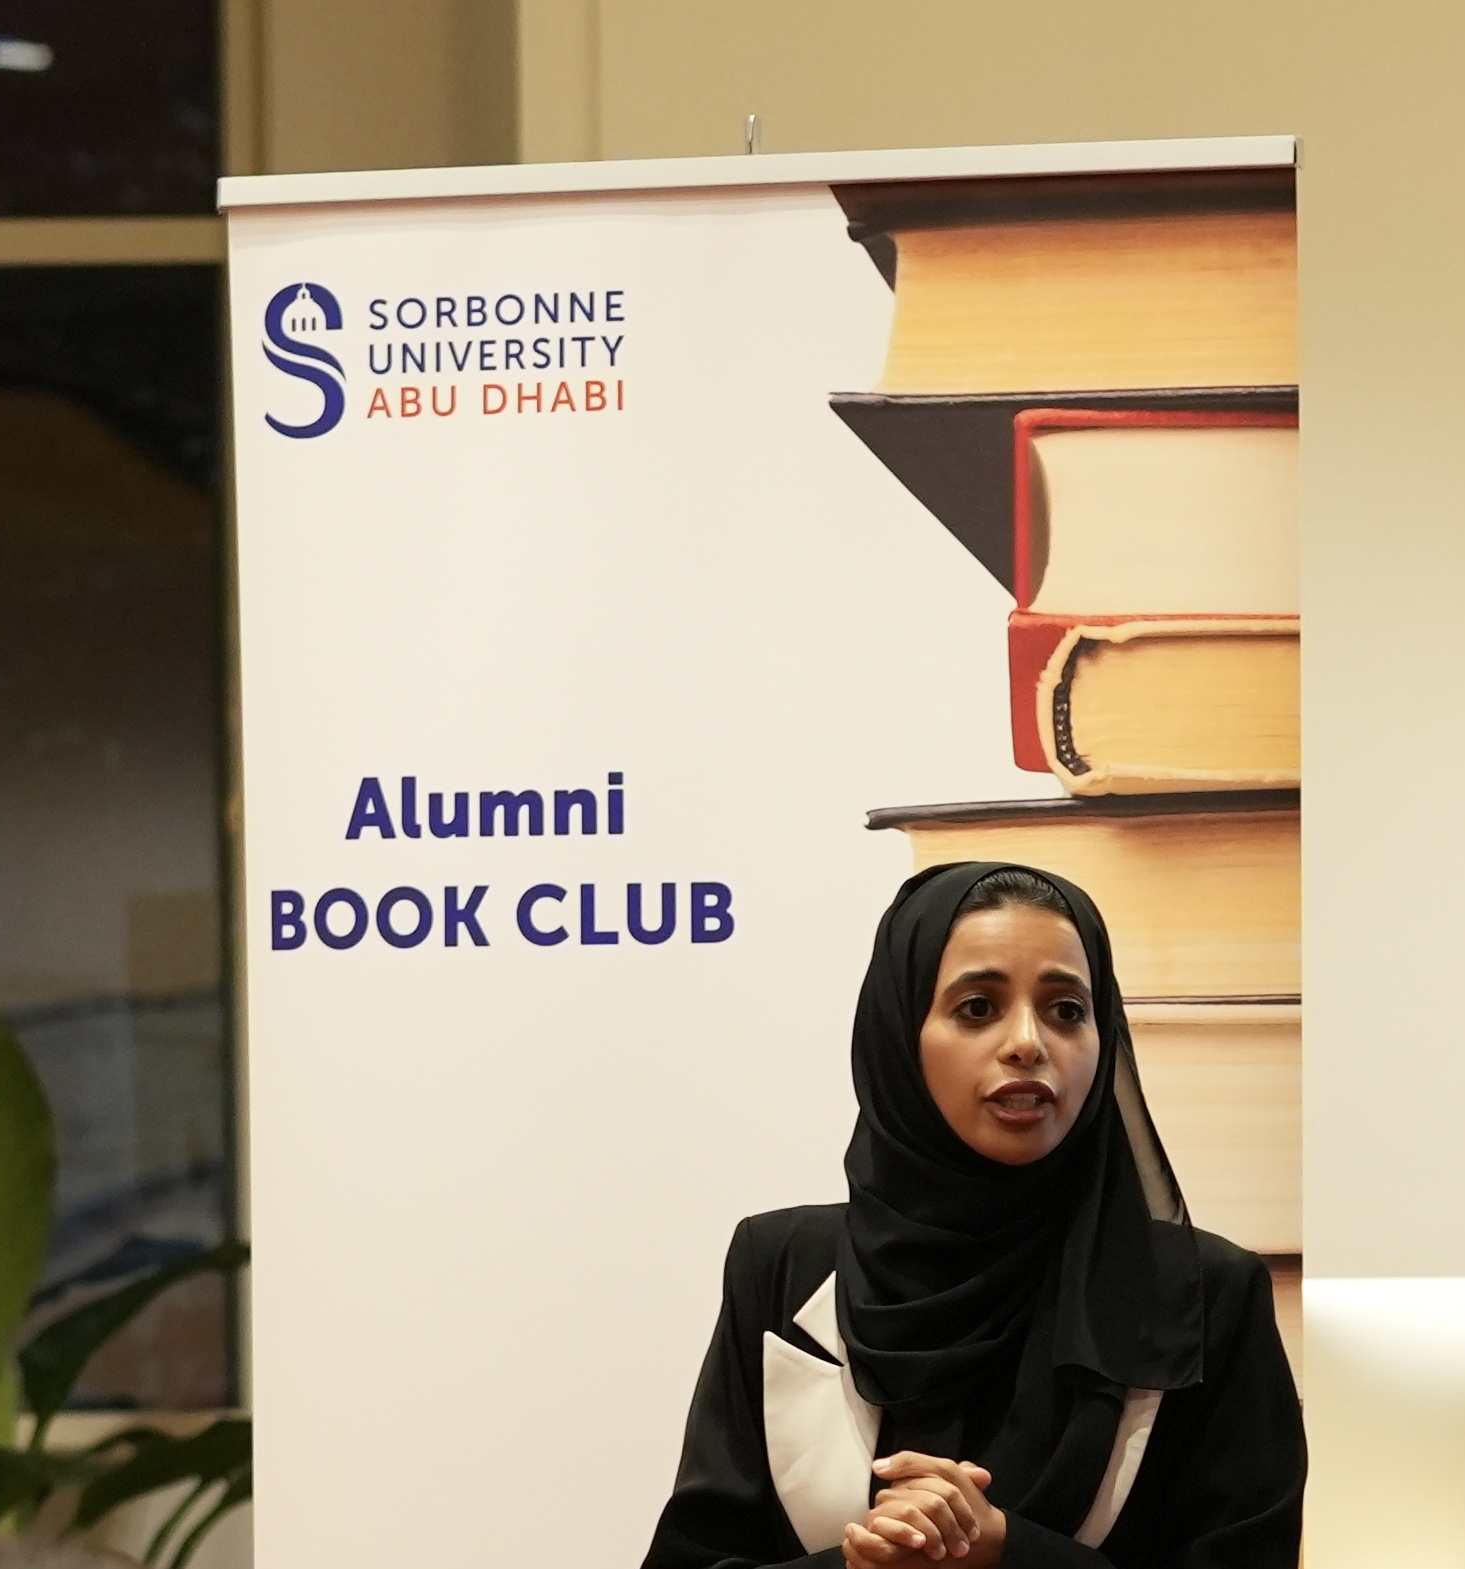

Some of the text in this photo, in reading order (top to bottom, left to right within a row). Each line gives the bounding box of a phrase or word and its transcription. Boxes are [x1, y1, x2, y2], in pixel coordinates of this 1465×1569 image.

[369, 290, 626, 331] SORBONNE
[368, 335, 626, 375] UNIVERSITY
[366, 379, 625, 419] ABU DHABI
[344, 771, 626, 841] Alumni
[270, 881, 736, 952] BOOK CLUB
